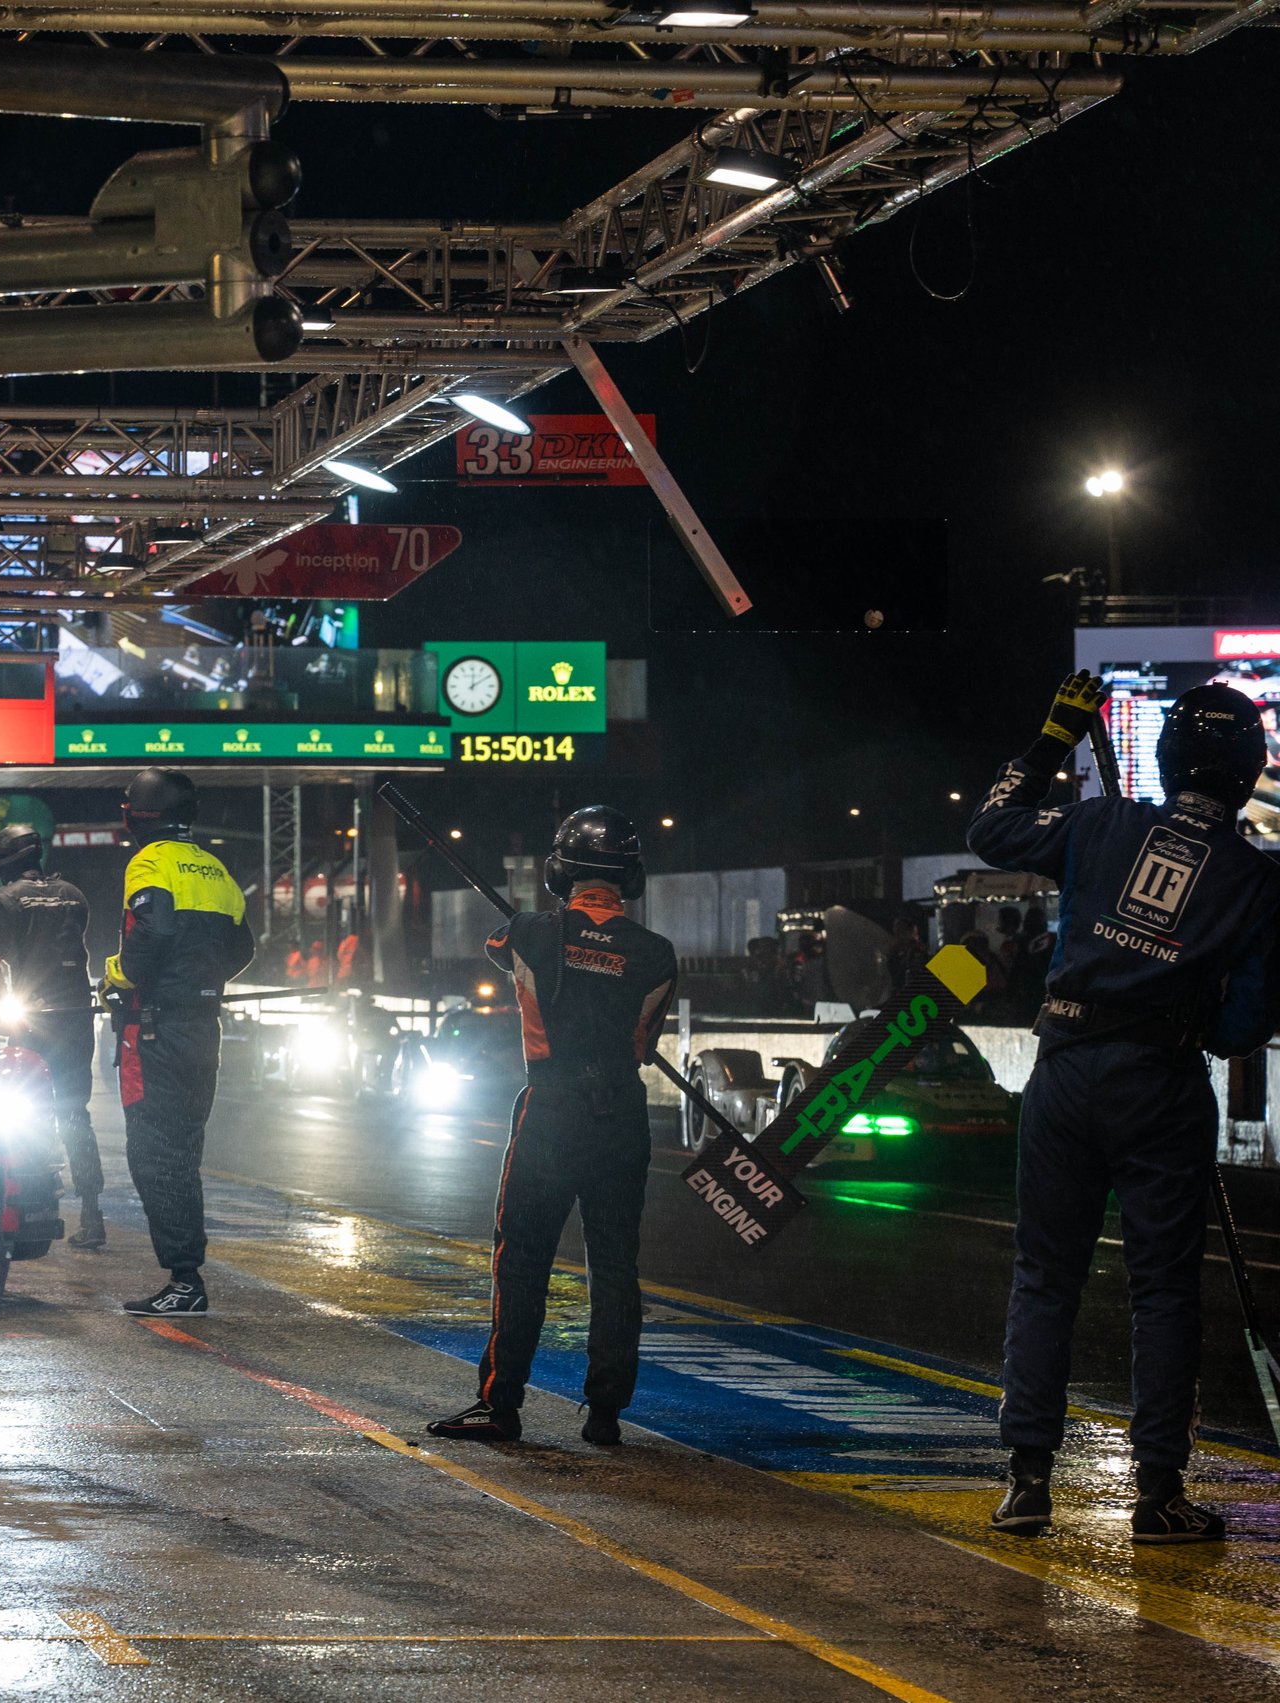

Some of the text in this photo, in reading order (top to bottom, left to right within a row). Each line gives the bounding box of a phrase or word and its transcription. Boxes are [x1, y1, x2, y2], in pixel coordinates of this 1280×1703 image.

[464, 426, 535, 476] 33
[296, 527, 430, 572] inception 70
[528, 686, 597, 702] ROLEX
[1205, 711, 1236, 721] COOKIE
[68, 743, 108, 753] ROLEX
[145, 742, 185, 753] ROLEX
[222, 742, 261, 753] ROLEX
[297, 743, 333, 753] ROLEX
[460, 735, 575, 761] 15:50:14
[1170, 813, 1212, 831] HRX
[176, 861, 224, 879] inceptio
[1138, 860, 1185, 902] IF
[1126, 903, 1170, 925] MILANO
[580, 929, 615, 944] HRX
[1093, 922, 1180, 963] DUQUEINE
[564, 961, 625, 977] NGINEERING
[779, 994, 940, 1156] START
[722, 1146, 785, 1208] YOUR
[685, 1168, 768, 1246] ENGINE
